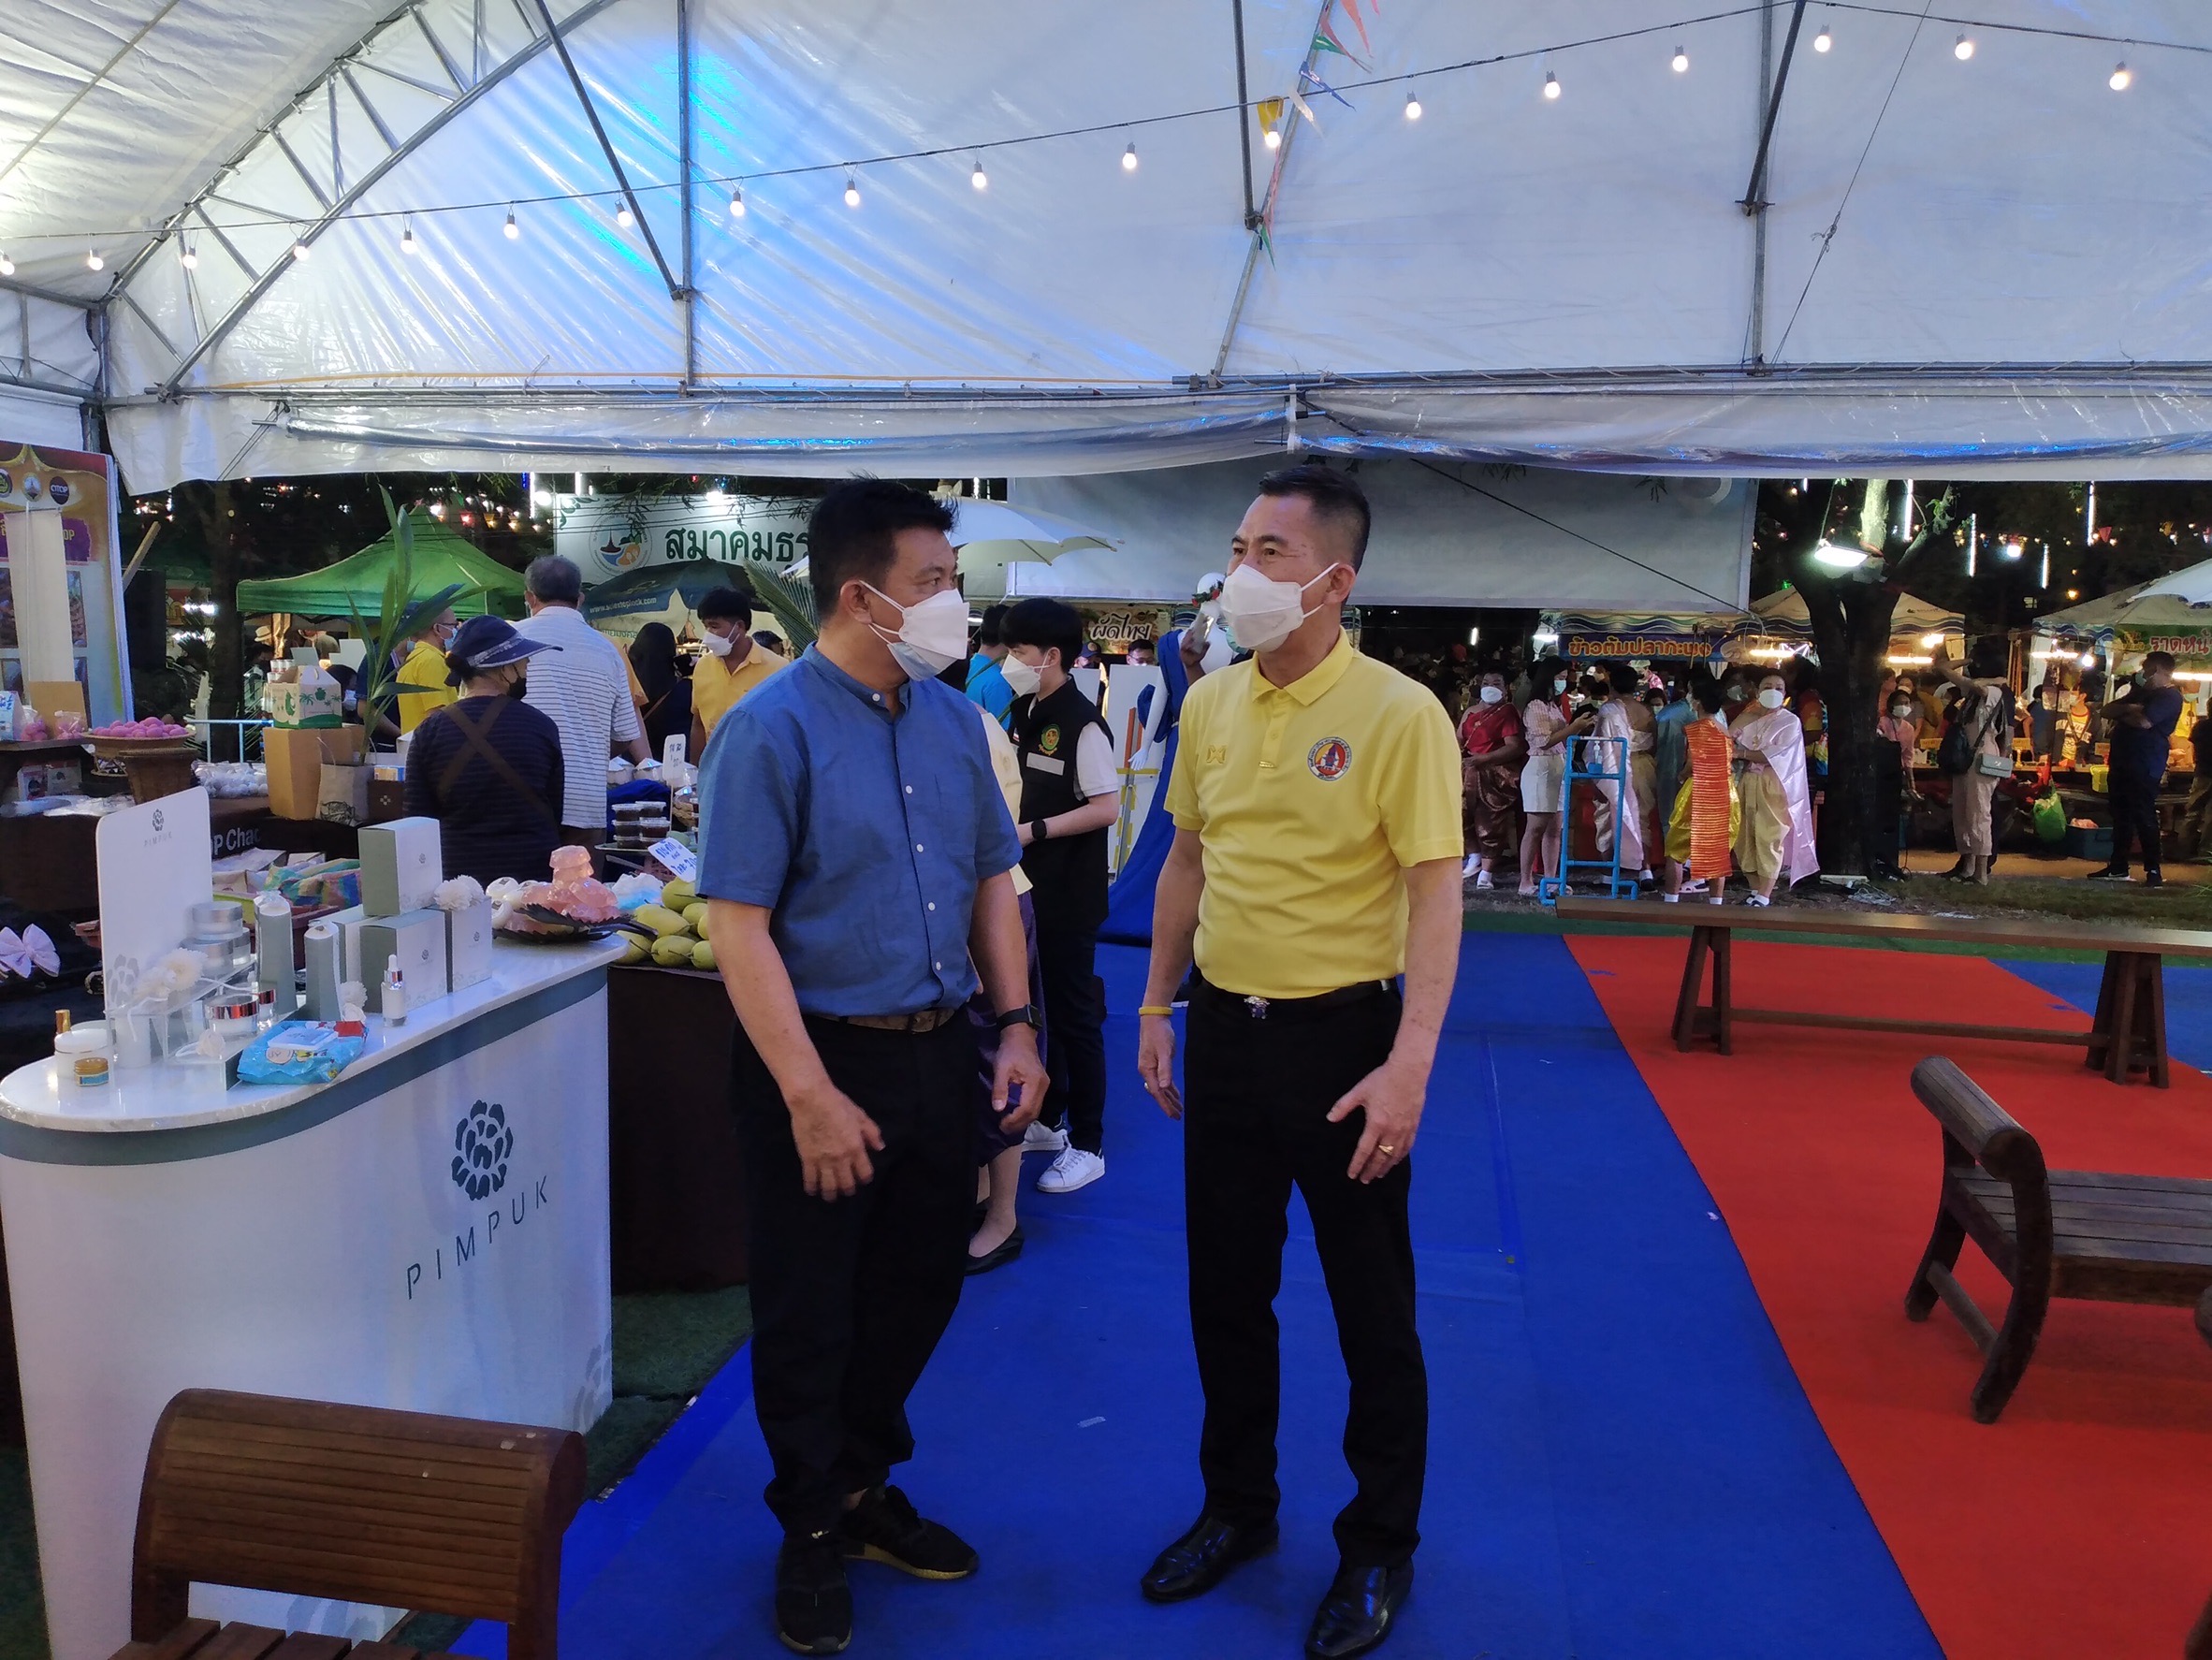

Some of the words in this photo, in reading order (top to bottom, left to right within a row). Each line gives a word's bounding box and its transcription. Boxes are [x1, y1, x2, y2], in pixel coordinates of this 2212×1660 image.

[1091, 612, 1152, 640] ผัดไทย
[2150, 628, 2212, 654] ราดหน้
[406, 1174, 547, 1300] PIMPUK
